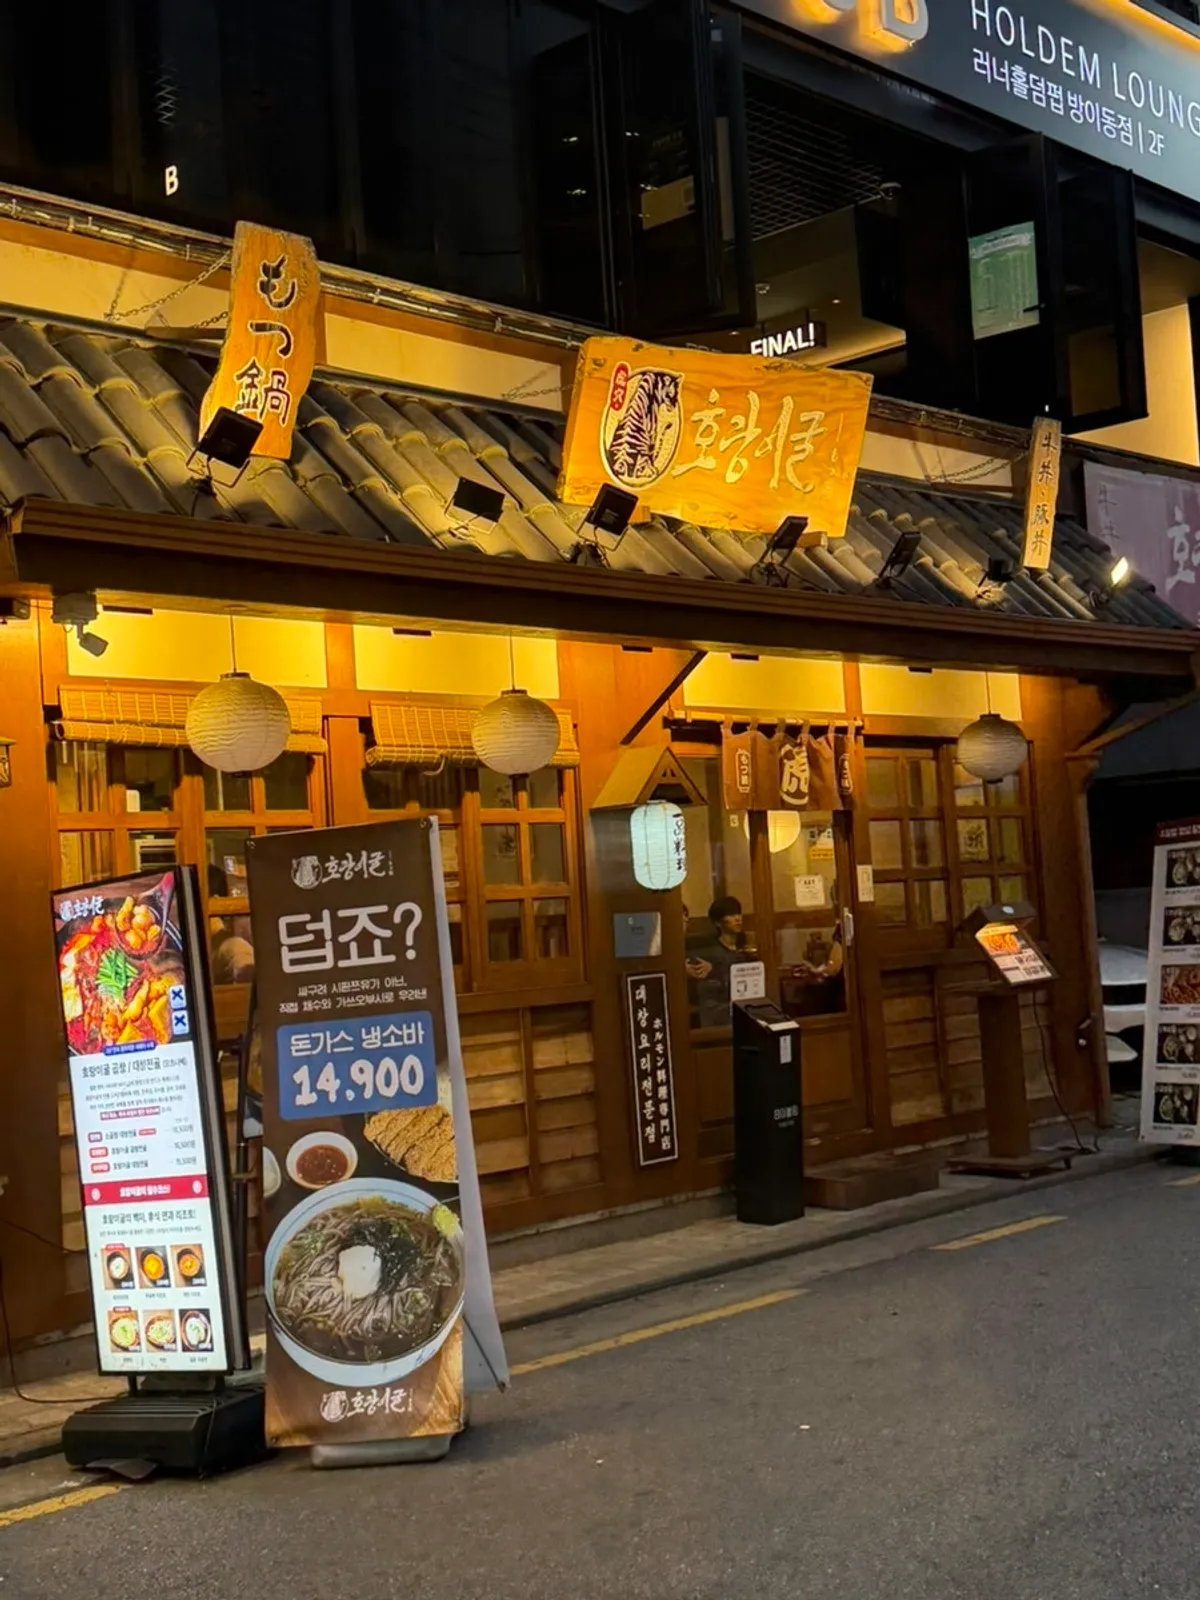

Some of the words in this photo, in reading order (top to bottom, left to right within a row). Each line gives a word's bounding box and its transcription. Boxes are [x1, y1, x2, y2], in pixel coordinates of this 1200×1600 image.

[971, 0, 1101, 89] HOLDEM
[1111, 62, 1200, 137] LOUNG
[972, 48, 1065, 116] 러너홀덤펍
[1066, 90, 1133, 147] 방이동점
[1147, 130, 1165, 157] 2F
[165, 165, 179, 196] B
[234, 254, 298, 428] もつ鍋
[750, 322, 815, 358] FINAL!
[277, 900, 424, 975] 덥죠?
[289, 1029, 355, 1057] 돈가스
[360, 1020, 425, 1050] 냉소바
[634, 984, 656, 1144] 대창요리전문점
[292, 1053, 425, 1107] 14.900
